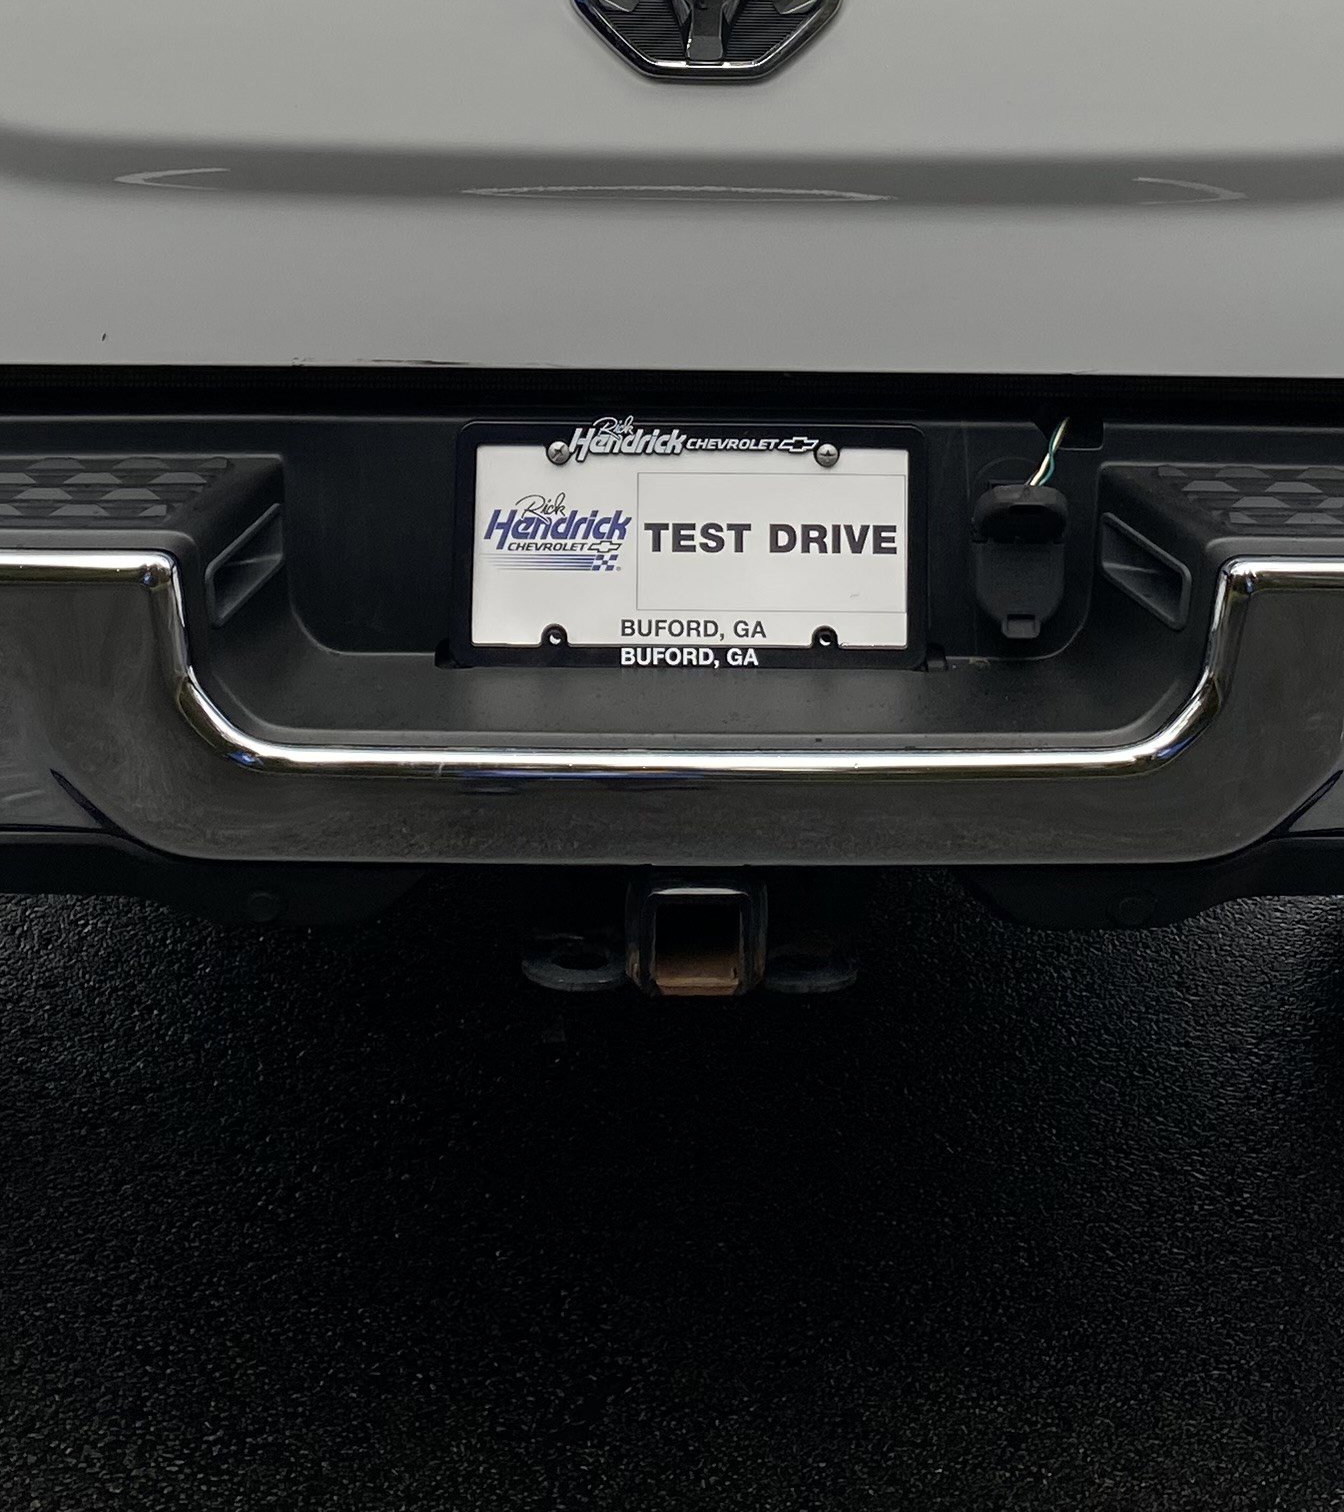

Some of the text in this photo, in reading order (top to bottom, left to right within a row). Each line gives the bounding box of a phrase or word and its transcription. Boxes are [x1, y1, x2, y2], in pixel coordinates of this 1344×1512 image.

[592, 415, 635, 439] Rick
[568, 428, 780, 462] Hendrick CHEVROLET
[515, 492, 566, 524] Rick
[483, 509, 633, 550] Hendrick
[643, 522, 899, 556] TEST DRIVE
[507, 541, 588, 552] CHEVROLET
[620, 619, 767, 641] BUFORD, GA
[620, 647, 759, 669] BUFORD, GA
